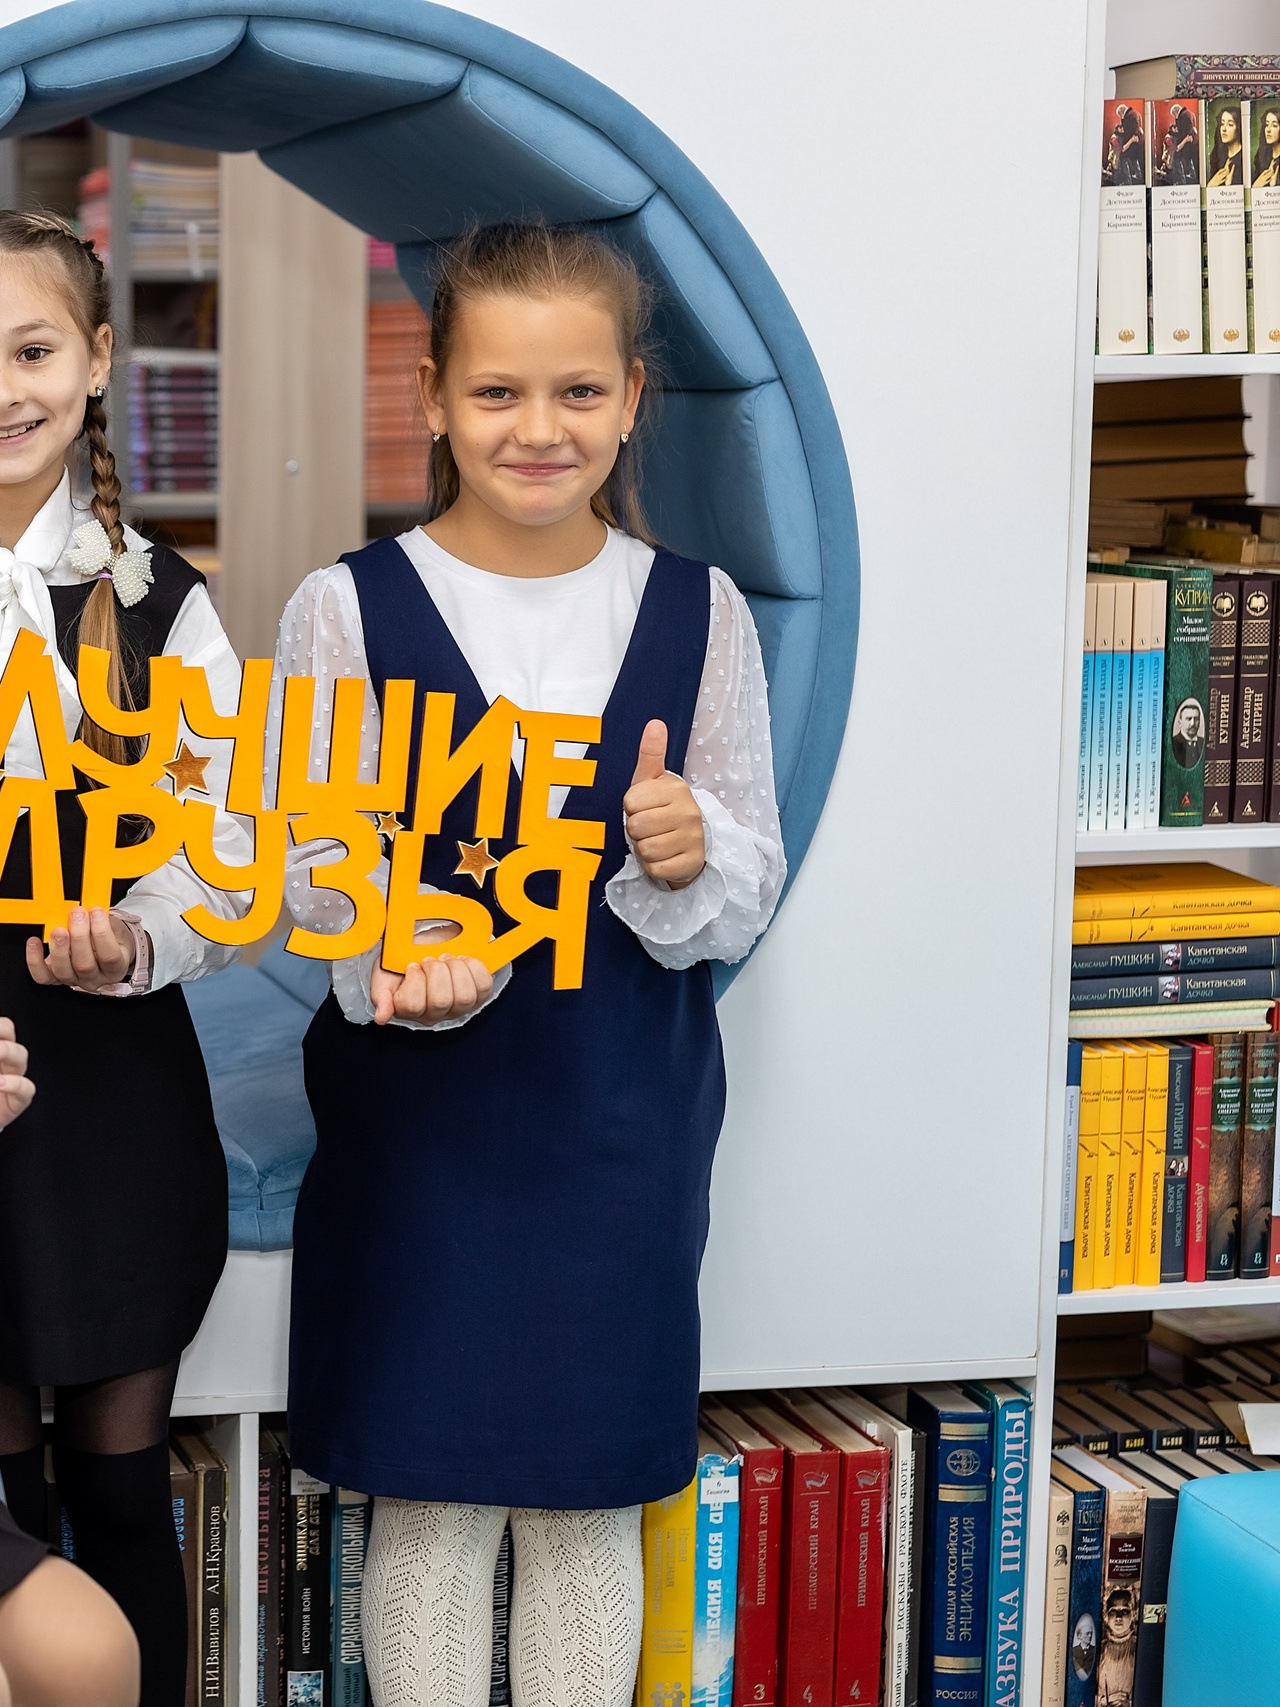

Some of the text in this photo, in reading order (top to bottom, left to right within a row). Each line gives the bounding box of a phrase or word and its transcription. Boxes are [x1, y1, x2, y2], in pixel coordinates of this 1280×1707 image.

[1175, 589, 1211, 607] КУПРИН
[1239, 686, 1255, 750] Александр
[1252, 693, 1264, 743] КУПРИН
[1187, 945, 1247, 956] Капитанская
[1187, 956, 1215, 966] дочка
[1186, 978, 1246, 989] Капитанская
[1186, 990, 1214, 999] дочка
[1174, 1183, 1185, 1247] Капитанская
[708, 1532, 722, 1570] ДЛЯ
[757, 1495, 768, 1606] ПРИМОРСКИЙ КРАЙ
[808, 1499, 820, 1610] ПРИМОРСКИЙ КРАЙ
[857, 1498, 871, 1608] ПРИМОРСКИЙ КРАЙ
[994, 1409, 1028, 1707] АЗБУКА ПРИРОДЫ
[206, 1505, 222, 1698] Н.И.Вавилов А.Н.Краснов
[341, 1506, 365, 1664] СПРАВОЧНИК ШКОЛЬНИКА
[945, 1515, 960, 1642] БОЛЬШАЯ РОССИЙСКАЯ
[958, 1516, 975, 1642] ЭНЦИКЛОПЕДИЯ
[301, 1613, 311, 1655] ИСТОРИЯ
[753, 1684, 765, 1701] 3
[803, 1685, 814, 1703] 4
[849, 1679, 860, 1699] 4
[935, 1689, 979, 1700] РОССИЯ
